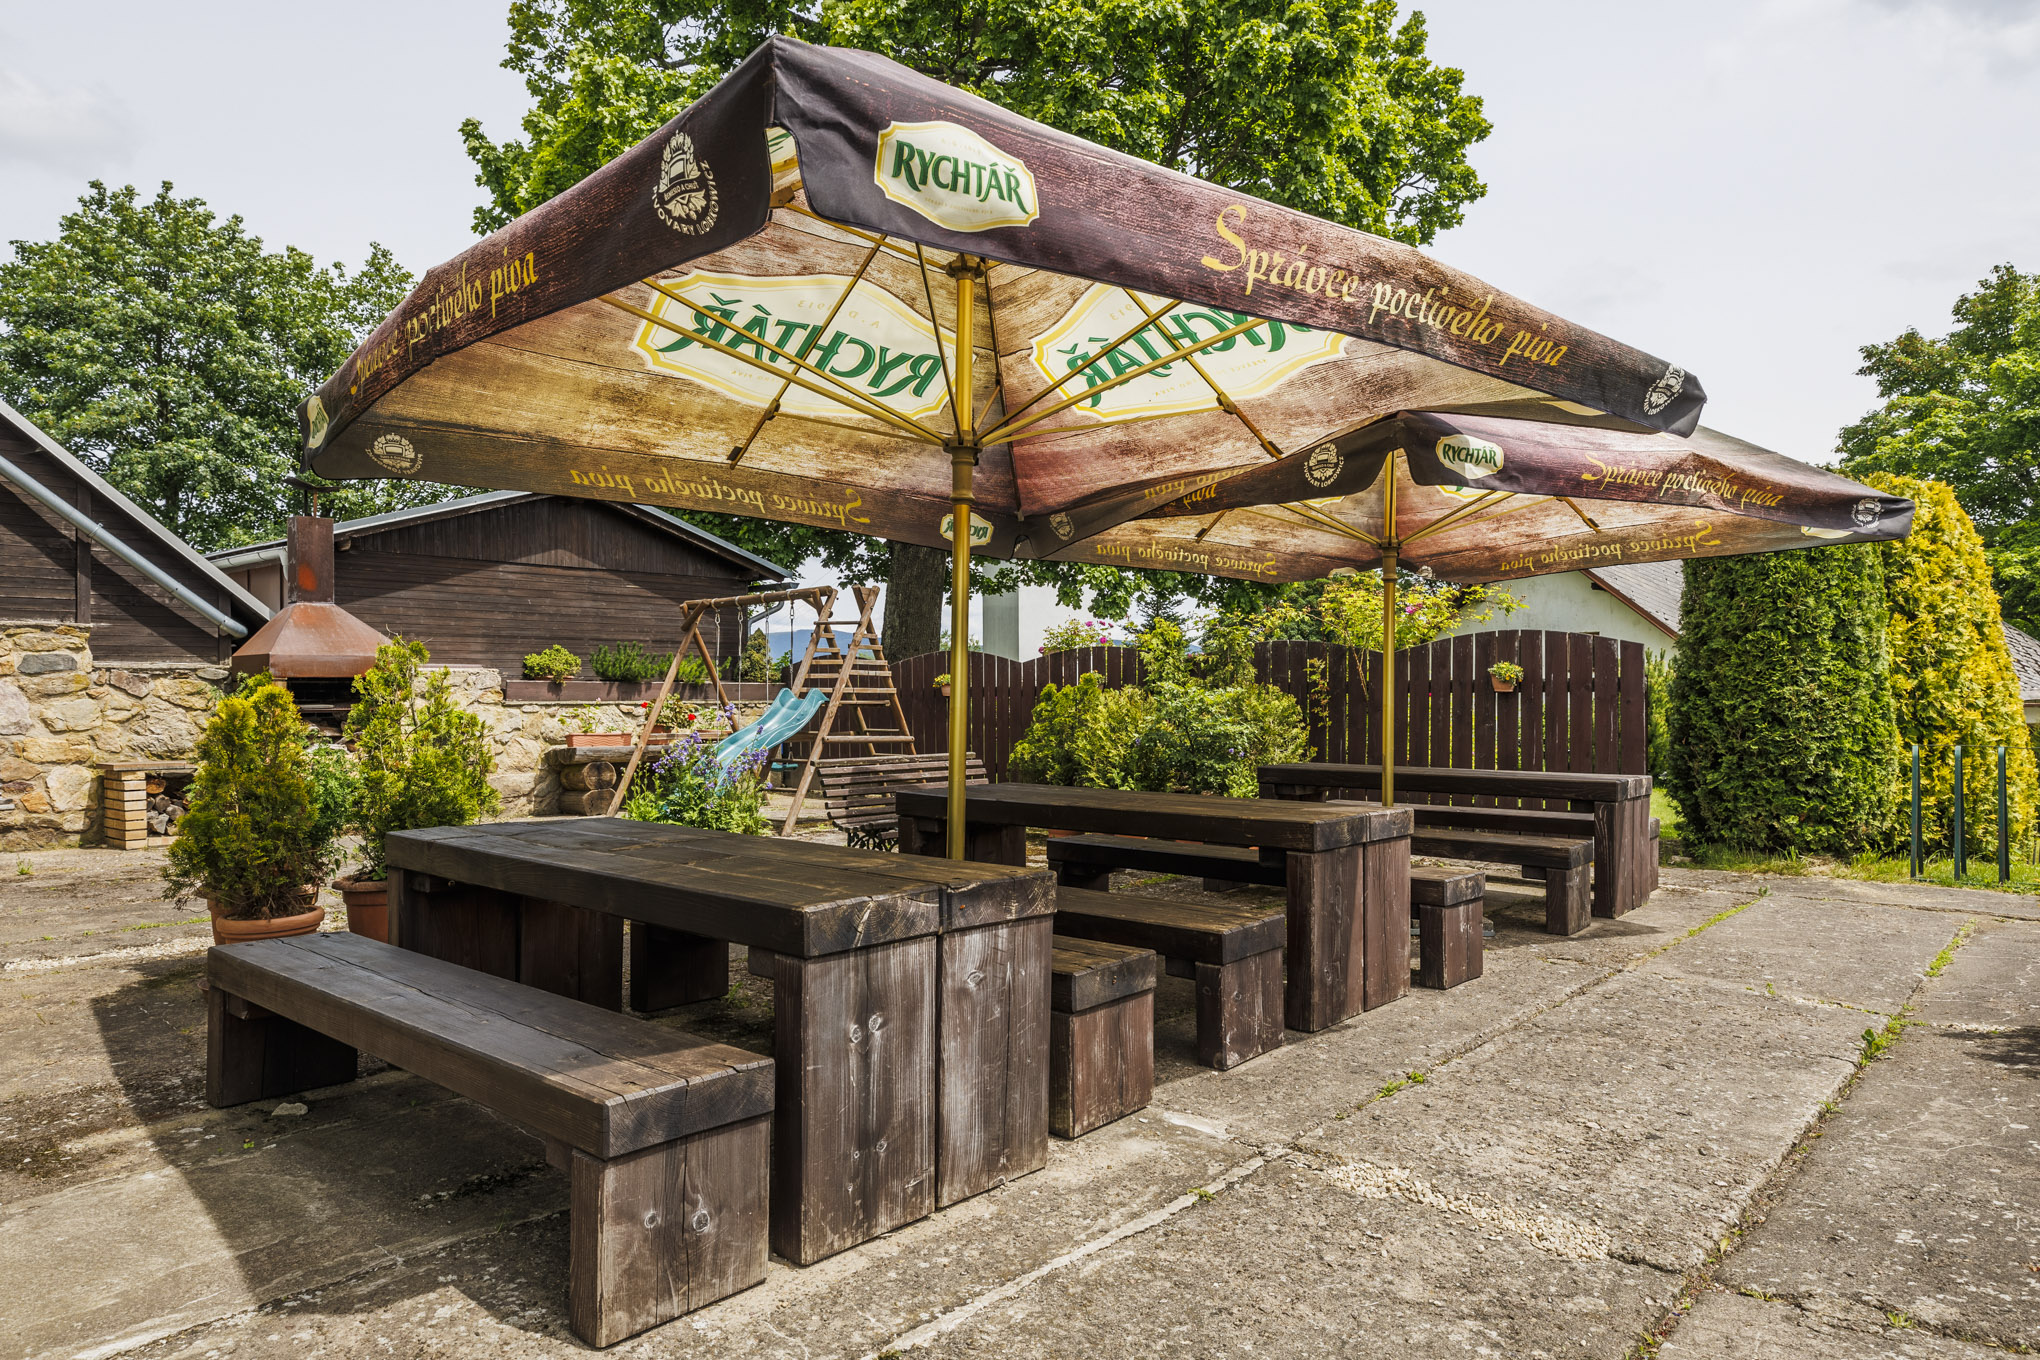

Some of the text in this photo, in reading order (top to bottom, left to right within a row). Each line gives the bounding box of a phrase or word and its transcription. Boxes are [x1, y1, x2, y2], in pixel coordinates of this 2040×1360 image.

[891, 139, 1030, 215] RYCHTÁŘ
[652, 185, 695, 236] PIVOVARY
[488, 246, 539, 319] piva
[1201, 204, 1568, 367] Správce poctivého piva
[1442, 443, 1499, 469] RYCHTÁŘ
[1581, 452, 1784, 510] Správce poctivého piva
